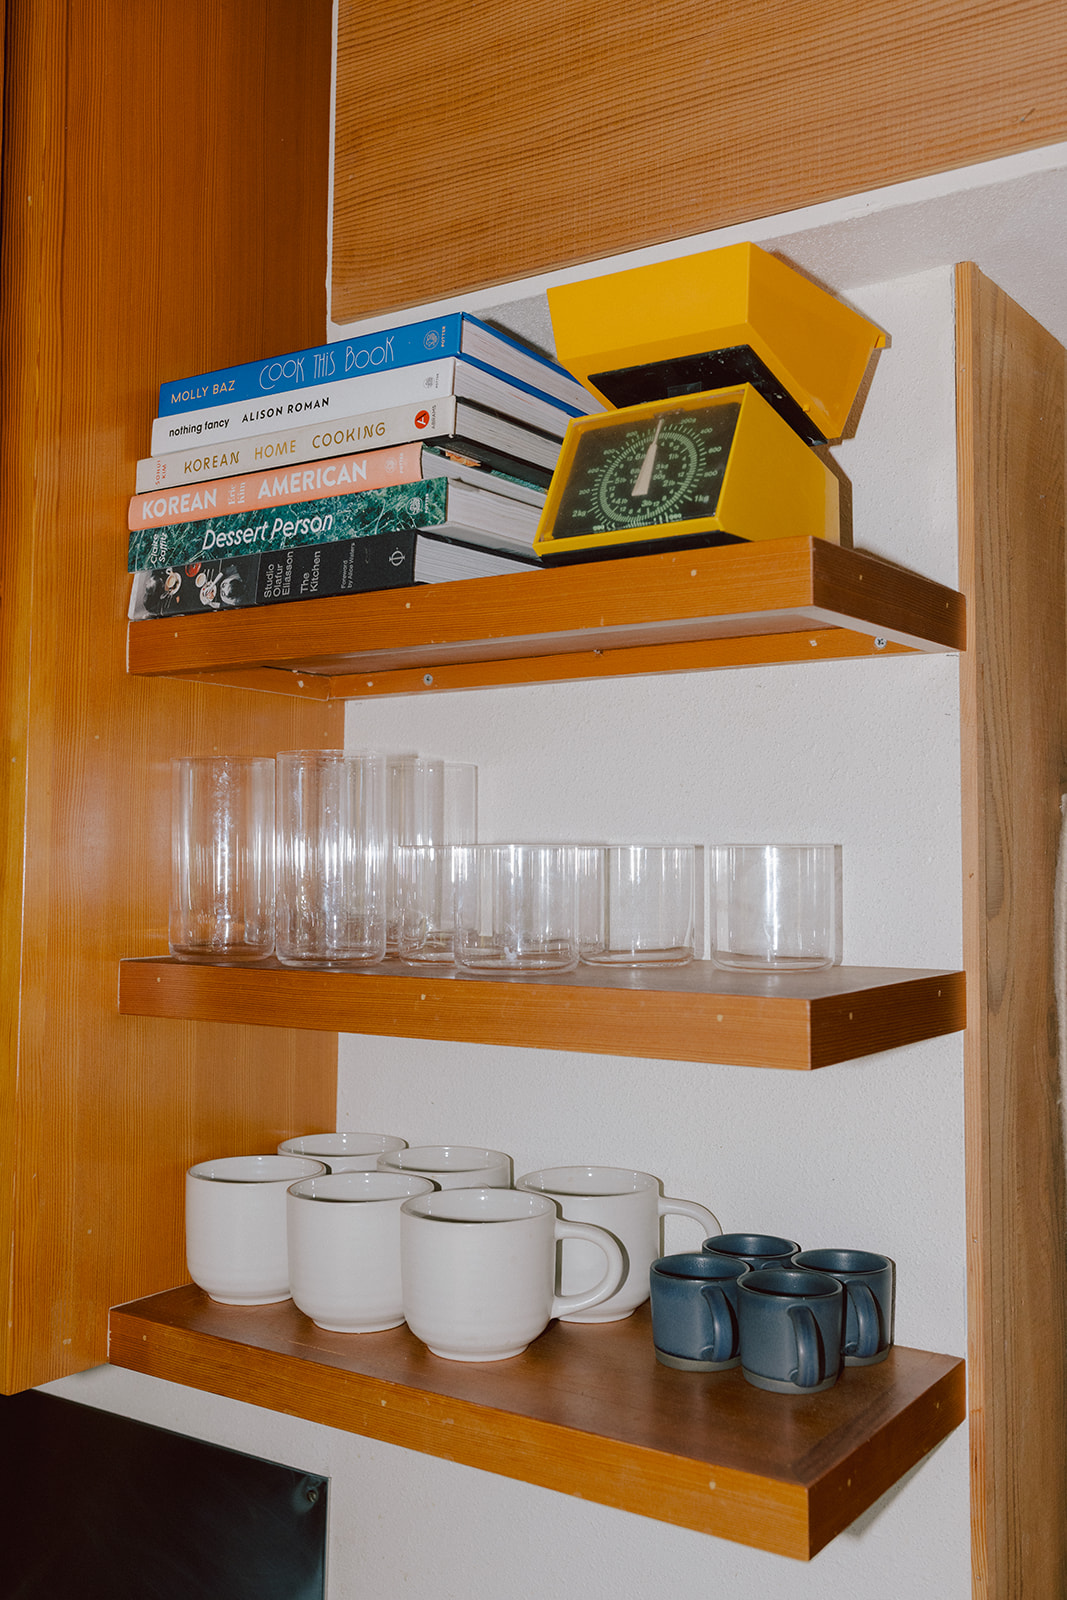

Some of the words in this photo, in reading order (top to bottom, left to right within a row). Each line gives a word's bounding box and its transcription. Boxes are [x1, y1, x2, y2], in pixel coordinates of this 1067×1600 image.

[259, 357, 305, 390] COOK
[345, 336, 395, 372] BOOK
[171, 386, 208, 404] MOLLY
[213, 380, 236, 395] BAZ
[242, 406, 283, 423] ALISON
[287, 397, 330, 414] ROMAN
[169, 423, 202, 437] nothing
[204, 418, 230, 431] fancy
[184, 451, 240, 474] KOREAN
[254, 440, 297, 461] HOME
[312, 422, 386, 449] COOKING
[237, 482, 246, 504] Kim
[257, 460, 367, 499] AMERICAN
[142, 488, 217, 520] KOREAN
[150, 533, 158, 564] Claire
[159, 532, 168, 563] Saffitz
[202, 521, 268, 550] Dessert
[270, 514, 333, 539] Person
[263, 563, 275, 598] Studio
[273, 563, 283, 597] Olafur
[282, 550, 294, 596] Eliasson
[300, 572, 310, 594] The
[310, 550, 321, 592] Kitchen
